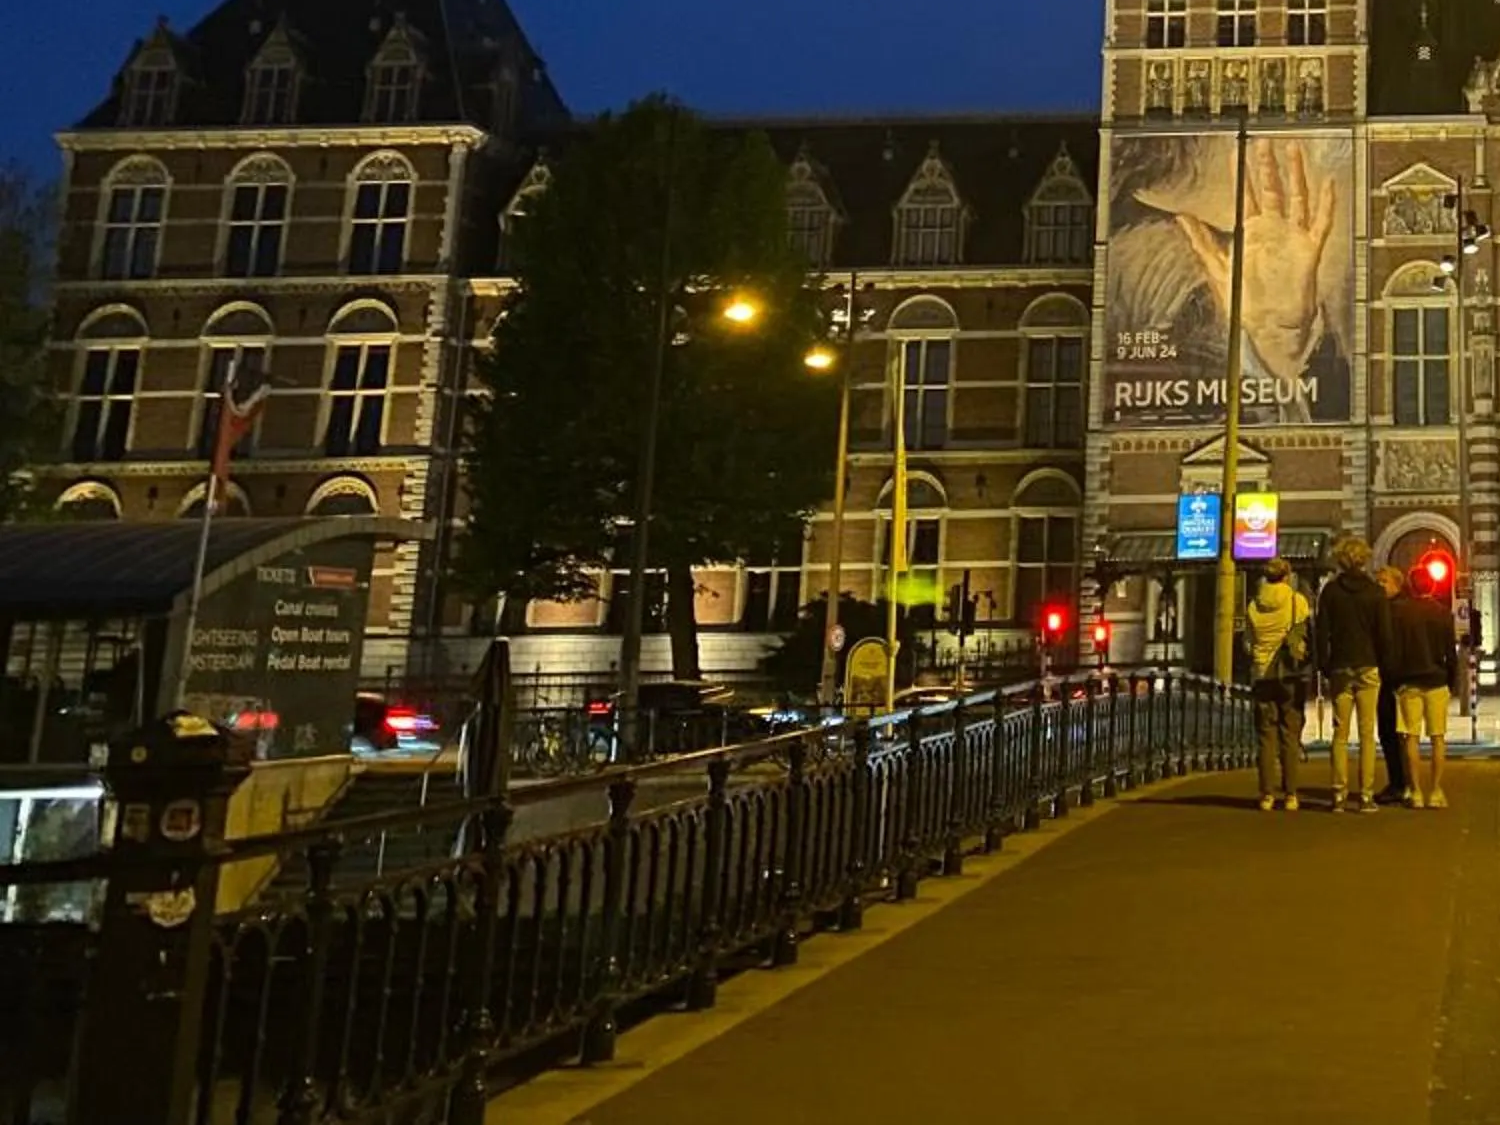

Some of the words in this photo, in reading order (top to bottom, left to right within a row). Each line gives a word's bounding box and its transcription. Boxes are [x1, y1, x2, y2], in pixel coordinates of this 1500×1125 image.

[1117, 332, 1132, 345] 16
[1117, 346, 1127, 360] 9
[1129, 346, 1157, 360] JUN
[1160, 343, 1177, 358] 24
[1115, 380, 1189, 406] RIJKS
[271, 626, 299, 645] Open
[301, 626, 324, 643] Boat
